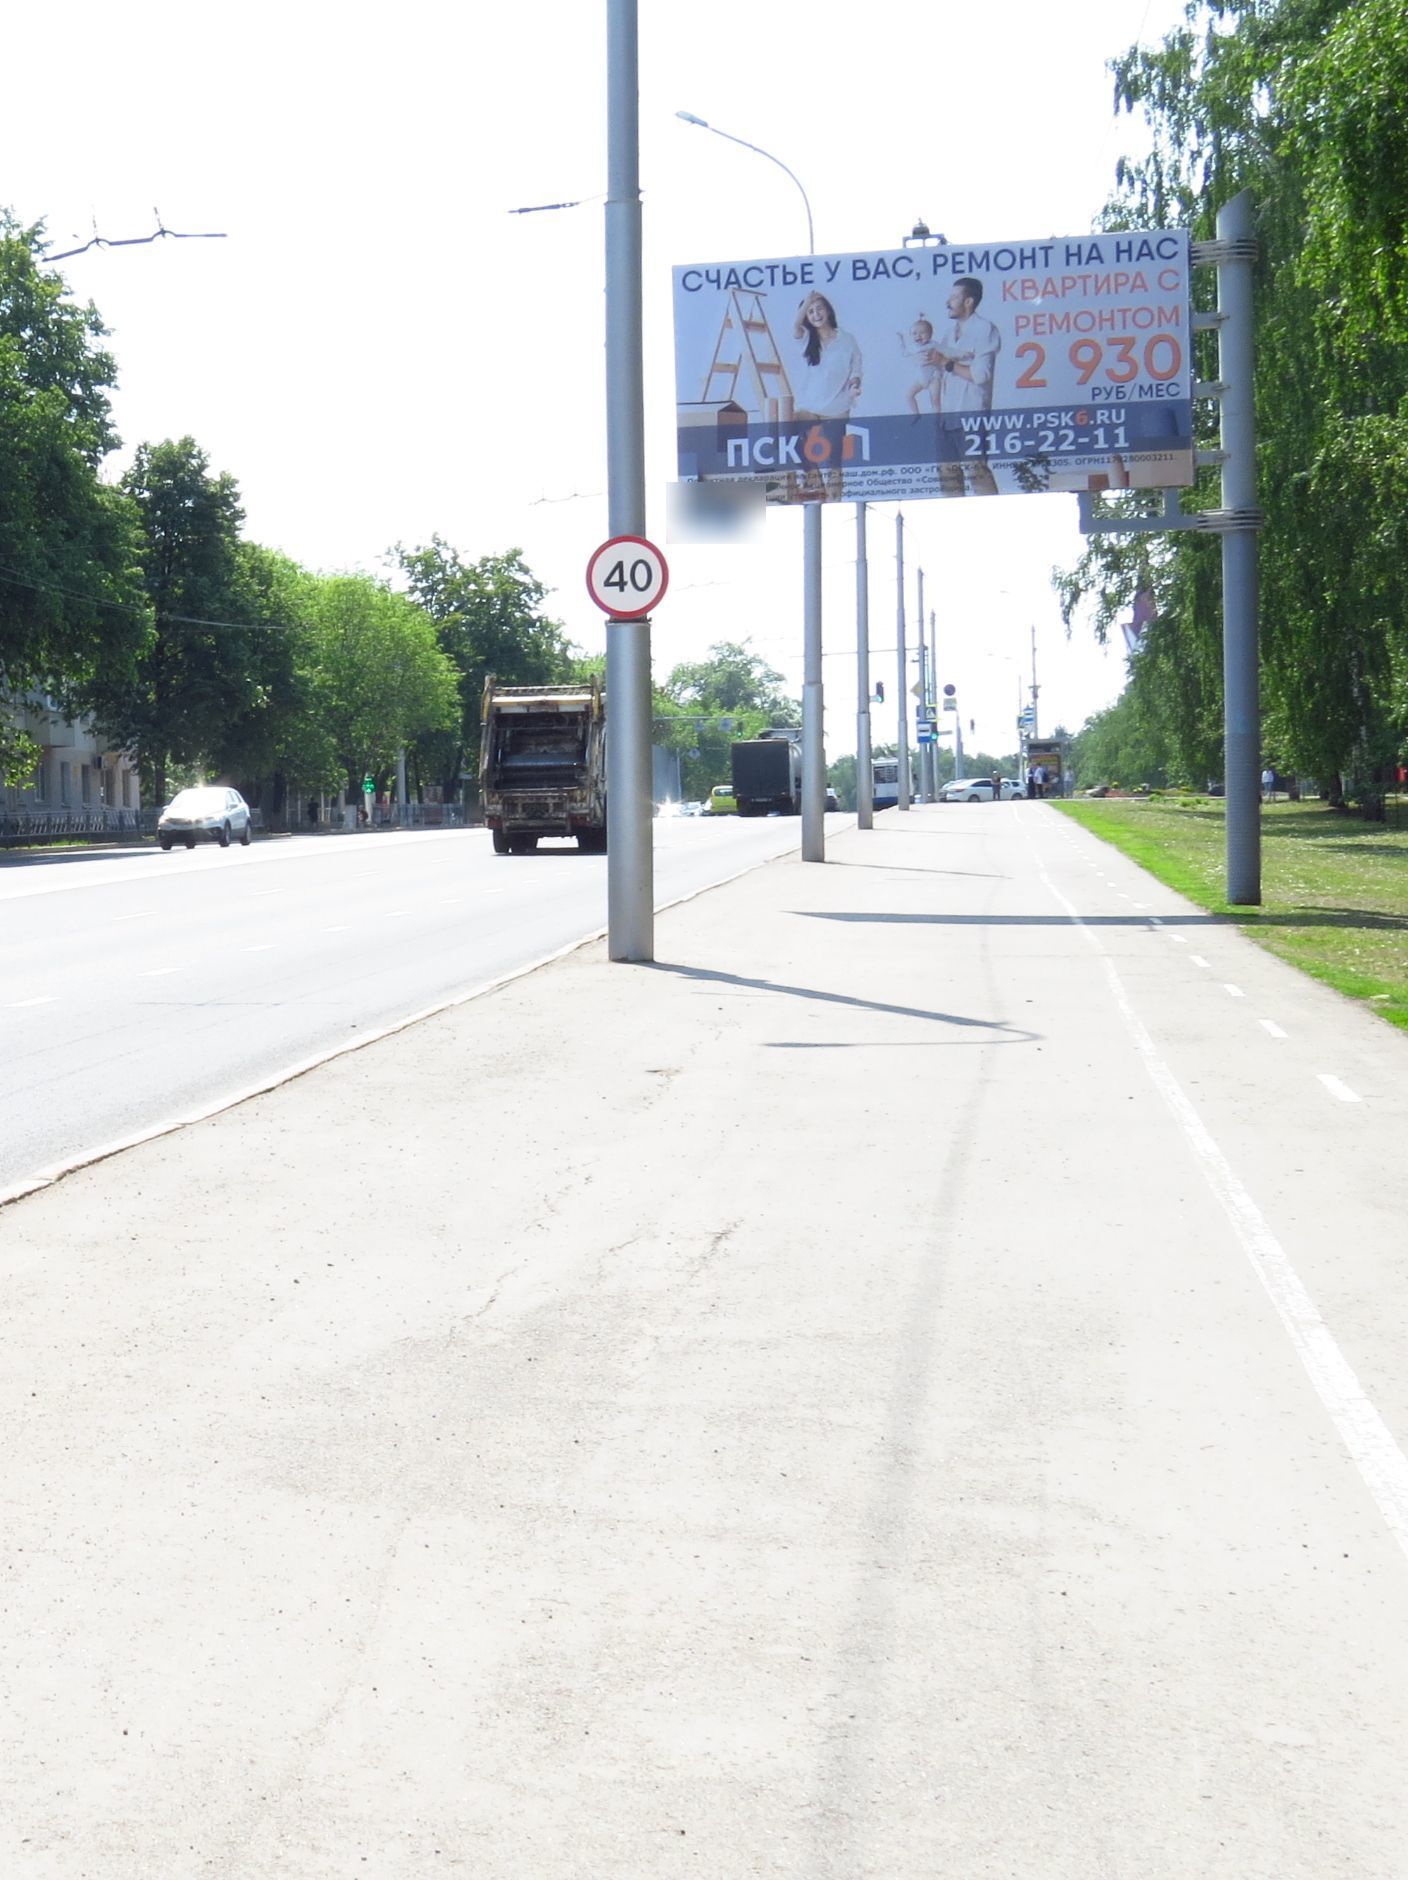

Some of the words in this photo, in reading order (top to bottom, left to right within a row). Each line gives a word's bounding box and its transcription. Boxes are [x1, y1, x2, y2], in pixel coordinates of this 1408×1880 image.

[682, 262, 814, 292] СЧАСТЬЕ
[824, 260, 841, 283] У
[851, 255, 921, 282] ВАС,
[932, 245, 1054, 276] РЕМОНТ
[1065, 242, 1104, 267] НА
[1115, 237, 1179, 263] НАС
[1002, 271, 1149, 302] КВАРТИРА
[1157, 269, 1180, 291] С
[1014, 305, 1180, 337] РЕМОНТОМ
[1015, 342, 1047, 389] 2
[1068, 333, 1182, 385] 930
[1092, 382, 1180, 401] РУБ/МЕС
[961, 408, 1126, 432] WWW.PSK6.RU
[964, 426, 1130, 456] 216-22-11
[602, 558, 653, 593] 40
